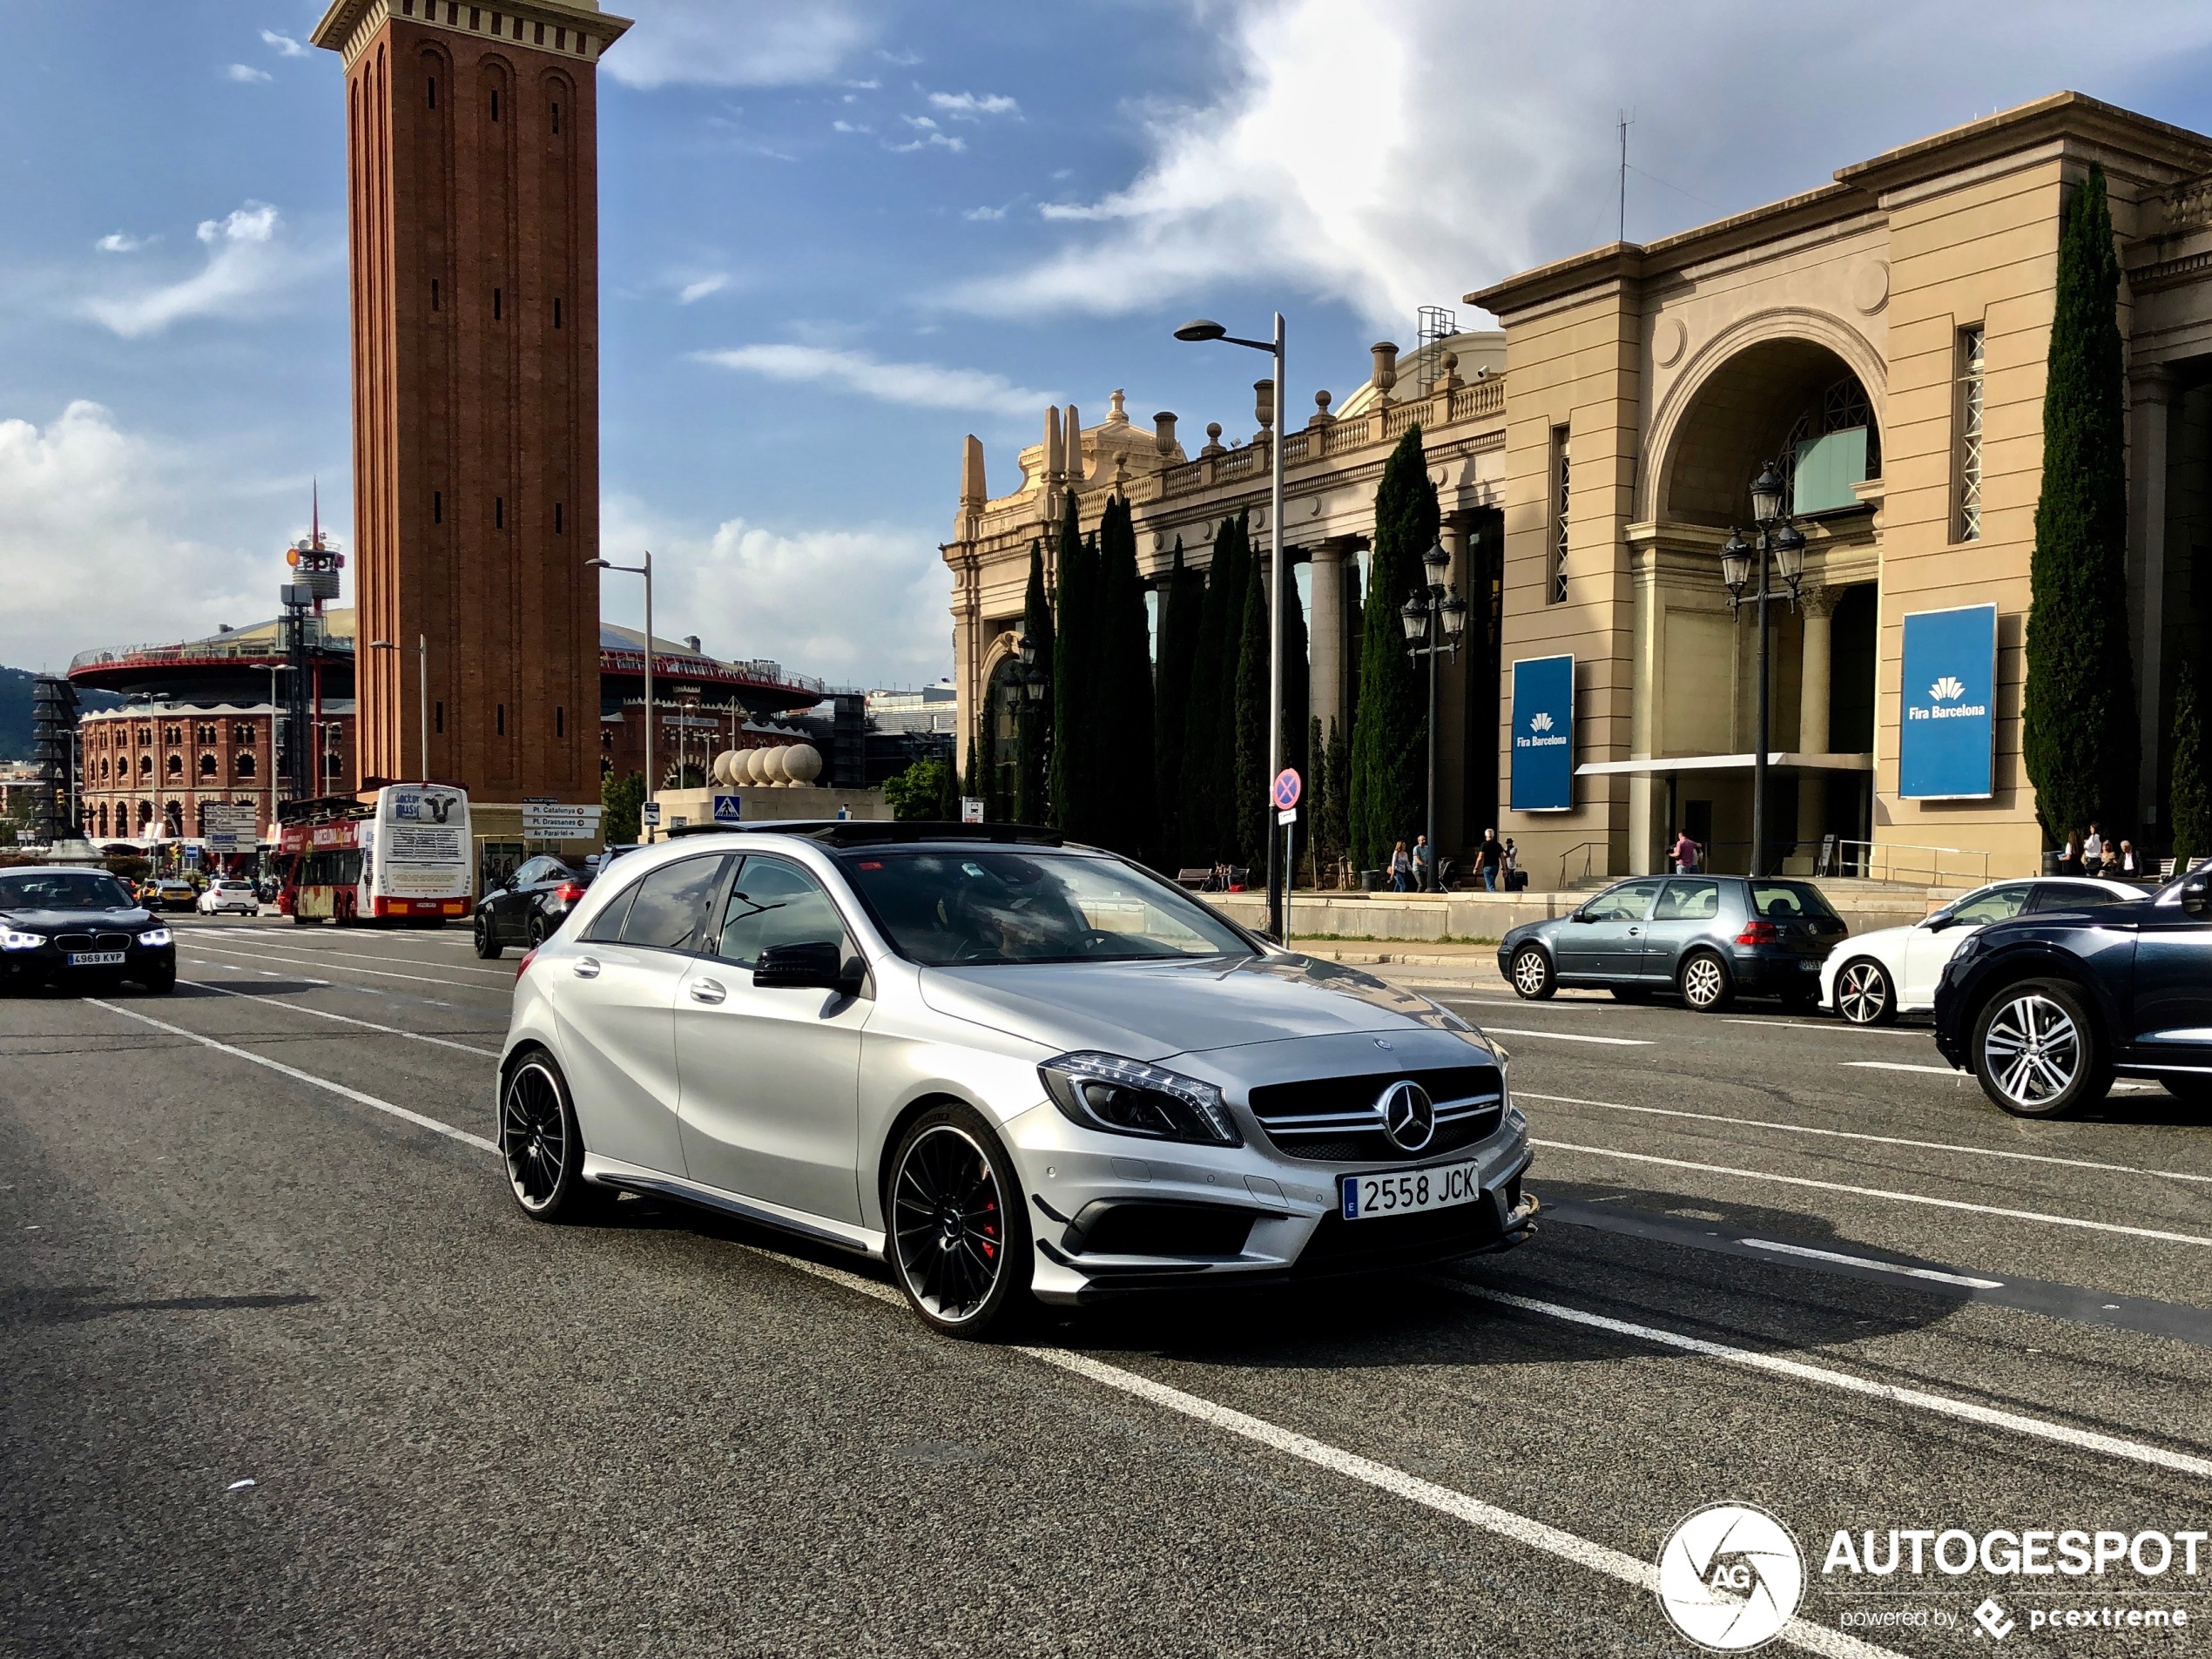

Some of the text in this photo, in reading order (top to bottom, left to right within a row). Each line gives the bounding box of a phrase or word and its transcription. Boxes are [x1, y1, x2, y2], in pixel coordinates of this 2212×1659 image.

[1909, 704, 1986, 719] Fira Barcelona
[1517, 734, 1567, 747] Fira Barcelona
[543, 806, 576, 815] Catalunya
[75, 953, 122, 963] 4969 KVP
[1348, 1167, 1475, 1212] E 2558 JCK
